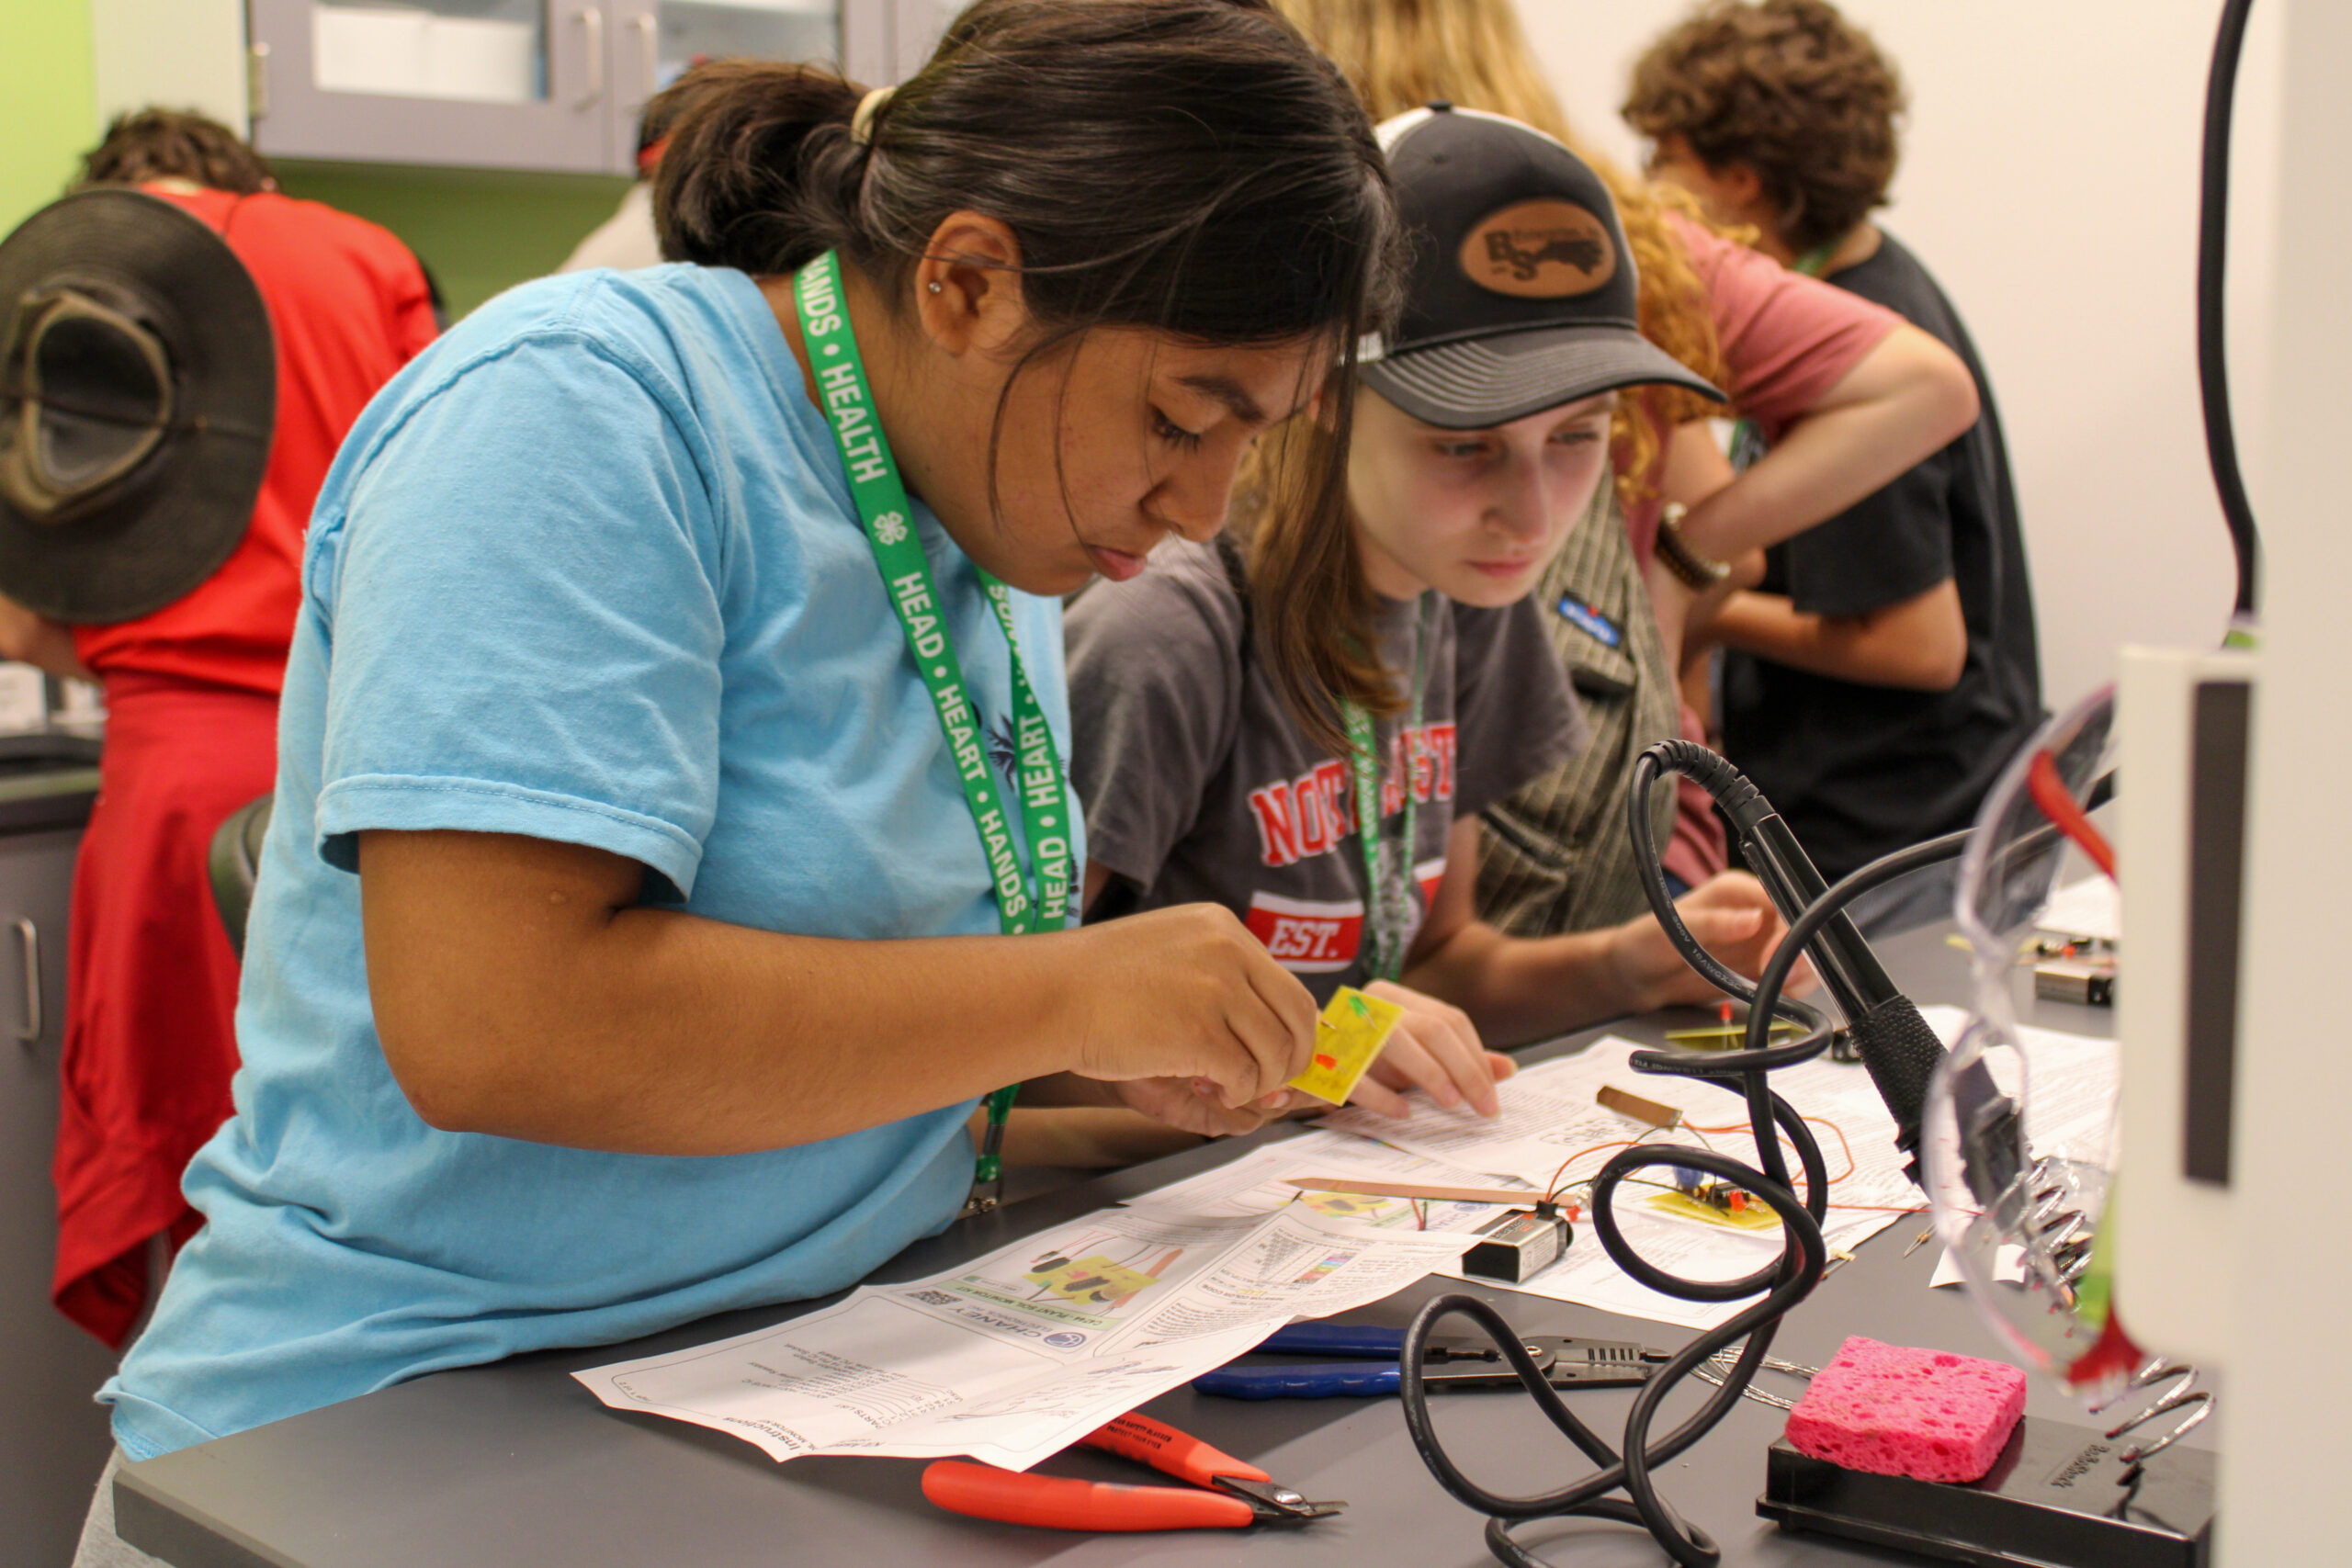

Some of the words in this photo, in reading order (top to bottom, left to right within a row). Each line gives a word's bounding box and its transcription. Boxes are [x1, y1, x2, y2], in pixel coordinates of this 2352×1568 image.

[821, 362, 888, 484] HEALTH
[893, 570, 945, 660] HEAD
[935, 682, 988, 784] HEART
[978, 807, 1029, 918] HANDS
[1018, 714, 1060, 808] HEART
[1038, 836, 1069, 919] HEAD
[1268, 919, 1341, 959] EST.
[944, 1307, 1042, 1337] CHANEY
[722, 1416, 801, 1451] Instructions
